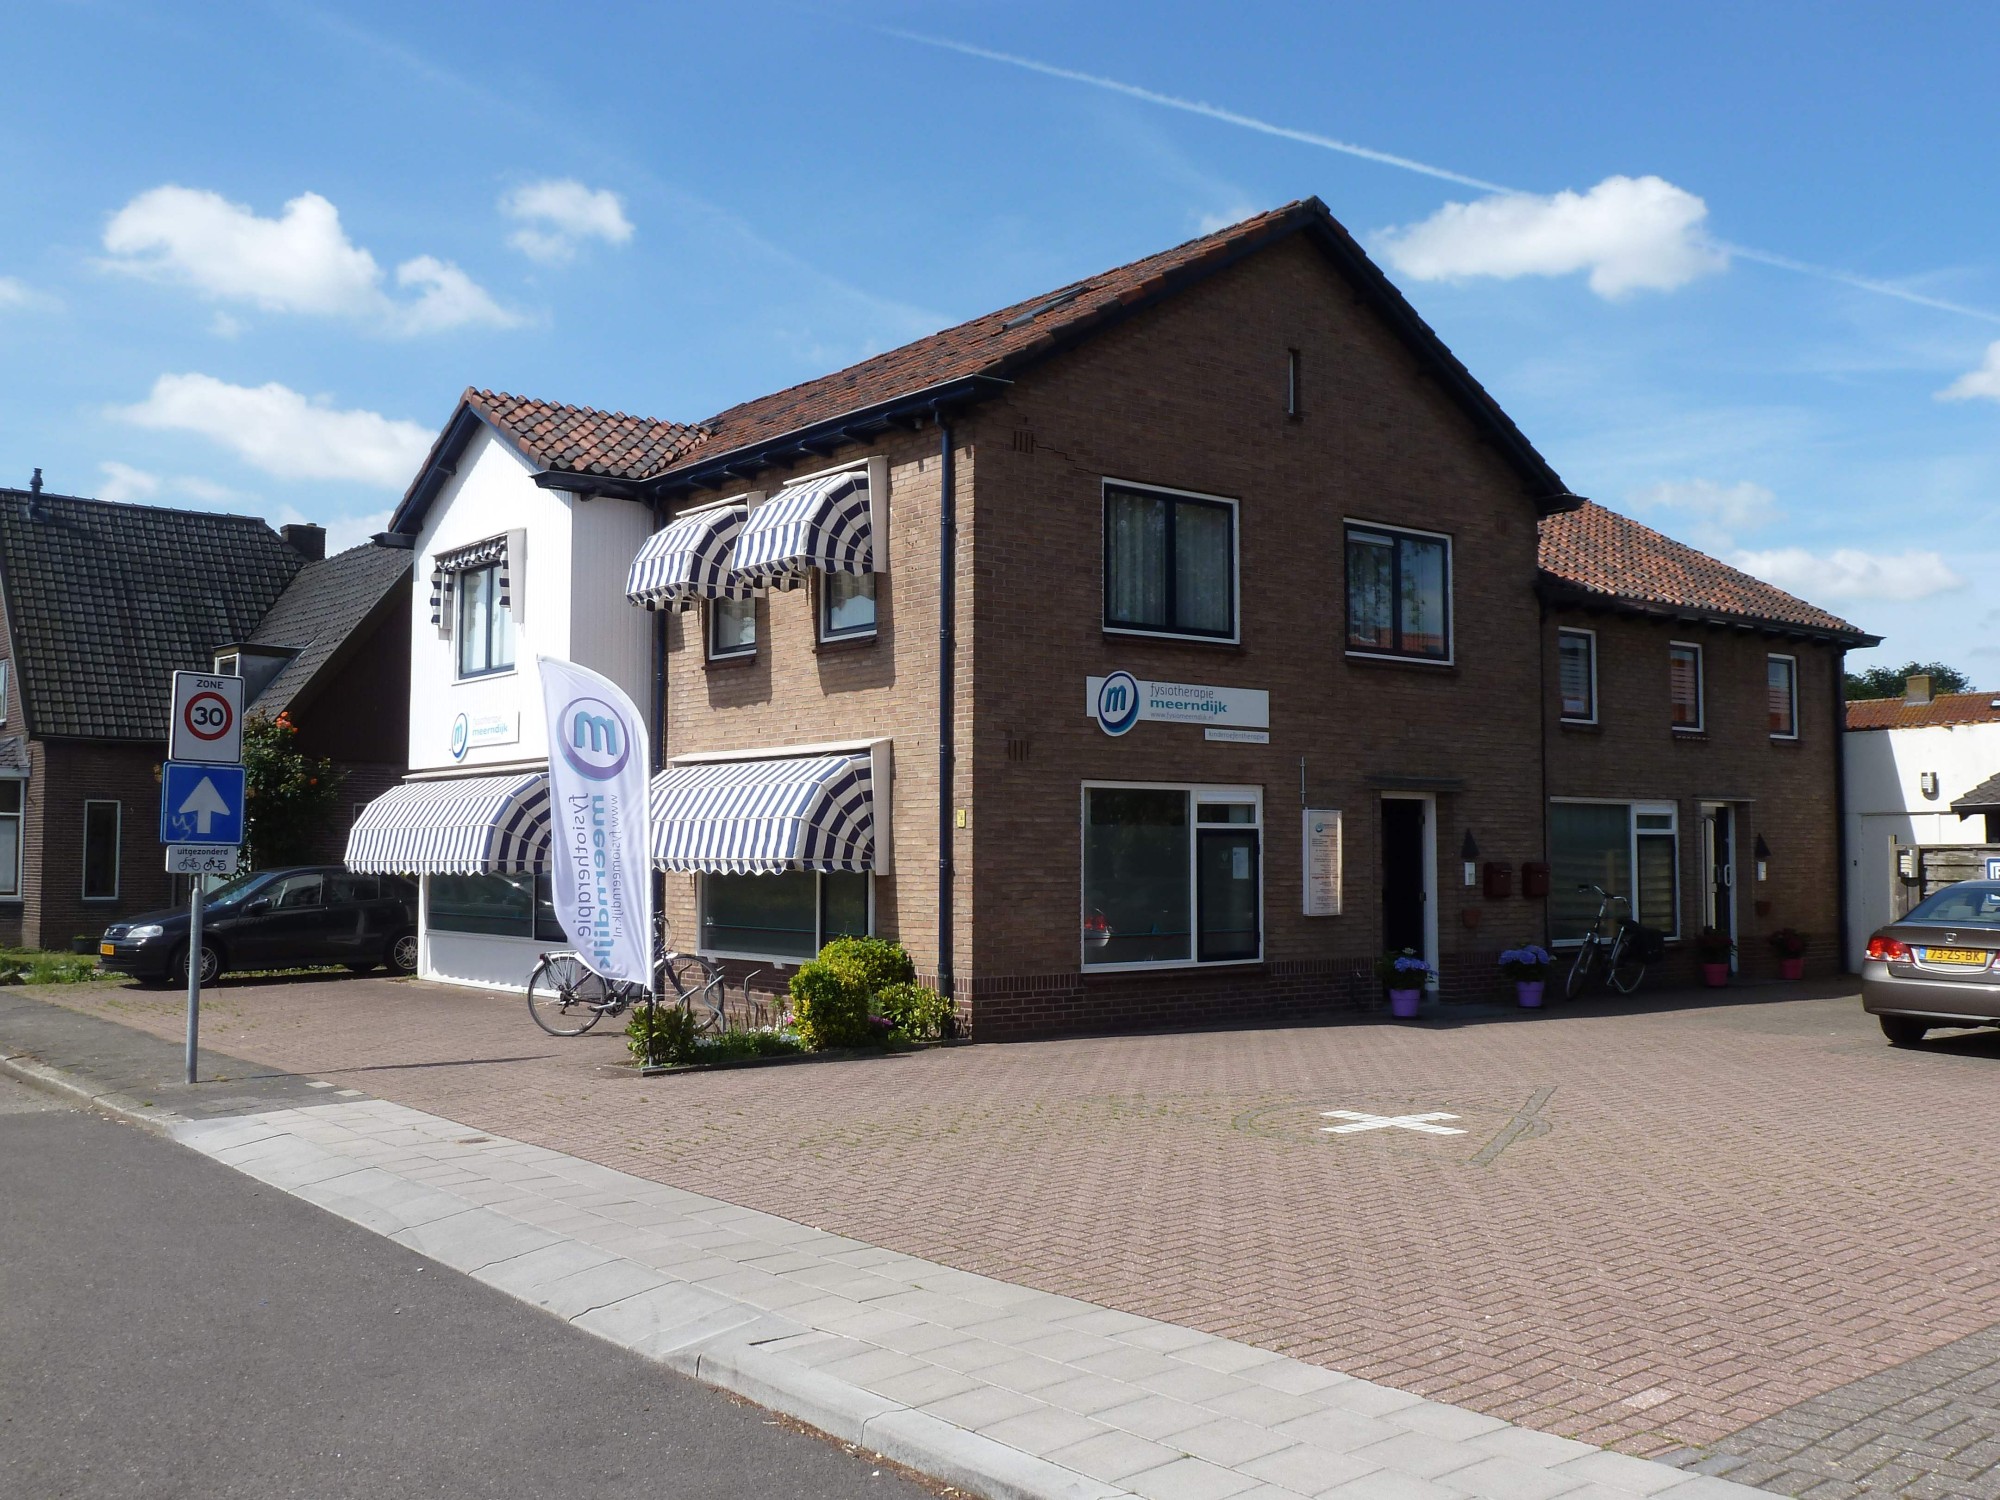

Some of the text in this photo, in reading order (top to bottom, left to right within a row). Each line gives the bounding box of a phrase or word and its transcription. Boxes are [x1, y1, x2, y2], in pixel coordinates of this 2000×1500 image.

[196, 679, 224, 690] ZONE
[1150, 683, 1214, 699] fysiotherapie
[1105, 684, 1127, 713] m
[1150, 699, 1228, 715] meerndijk
[193, 706, 224, 727] 30
[472, 723, 508, 736] meerndijk
[177, 848, 229, 856] uitgezonderd
[1930, 949, 1980, 961] 73-ZS-BK
